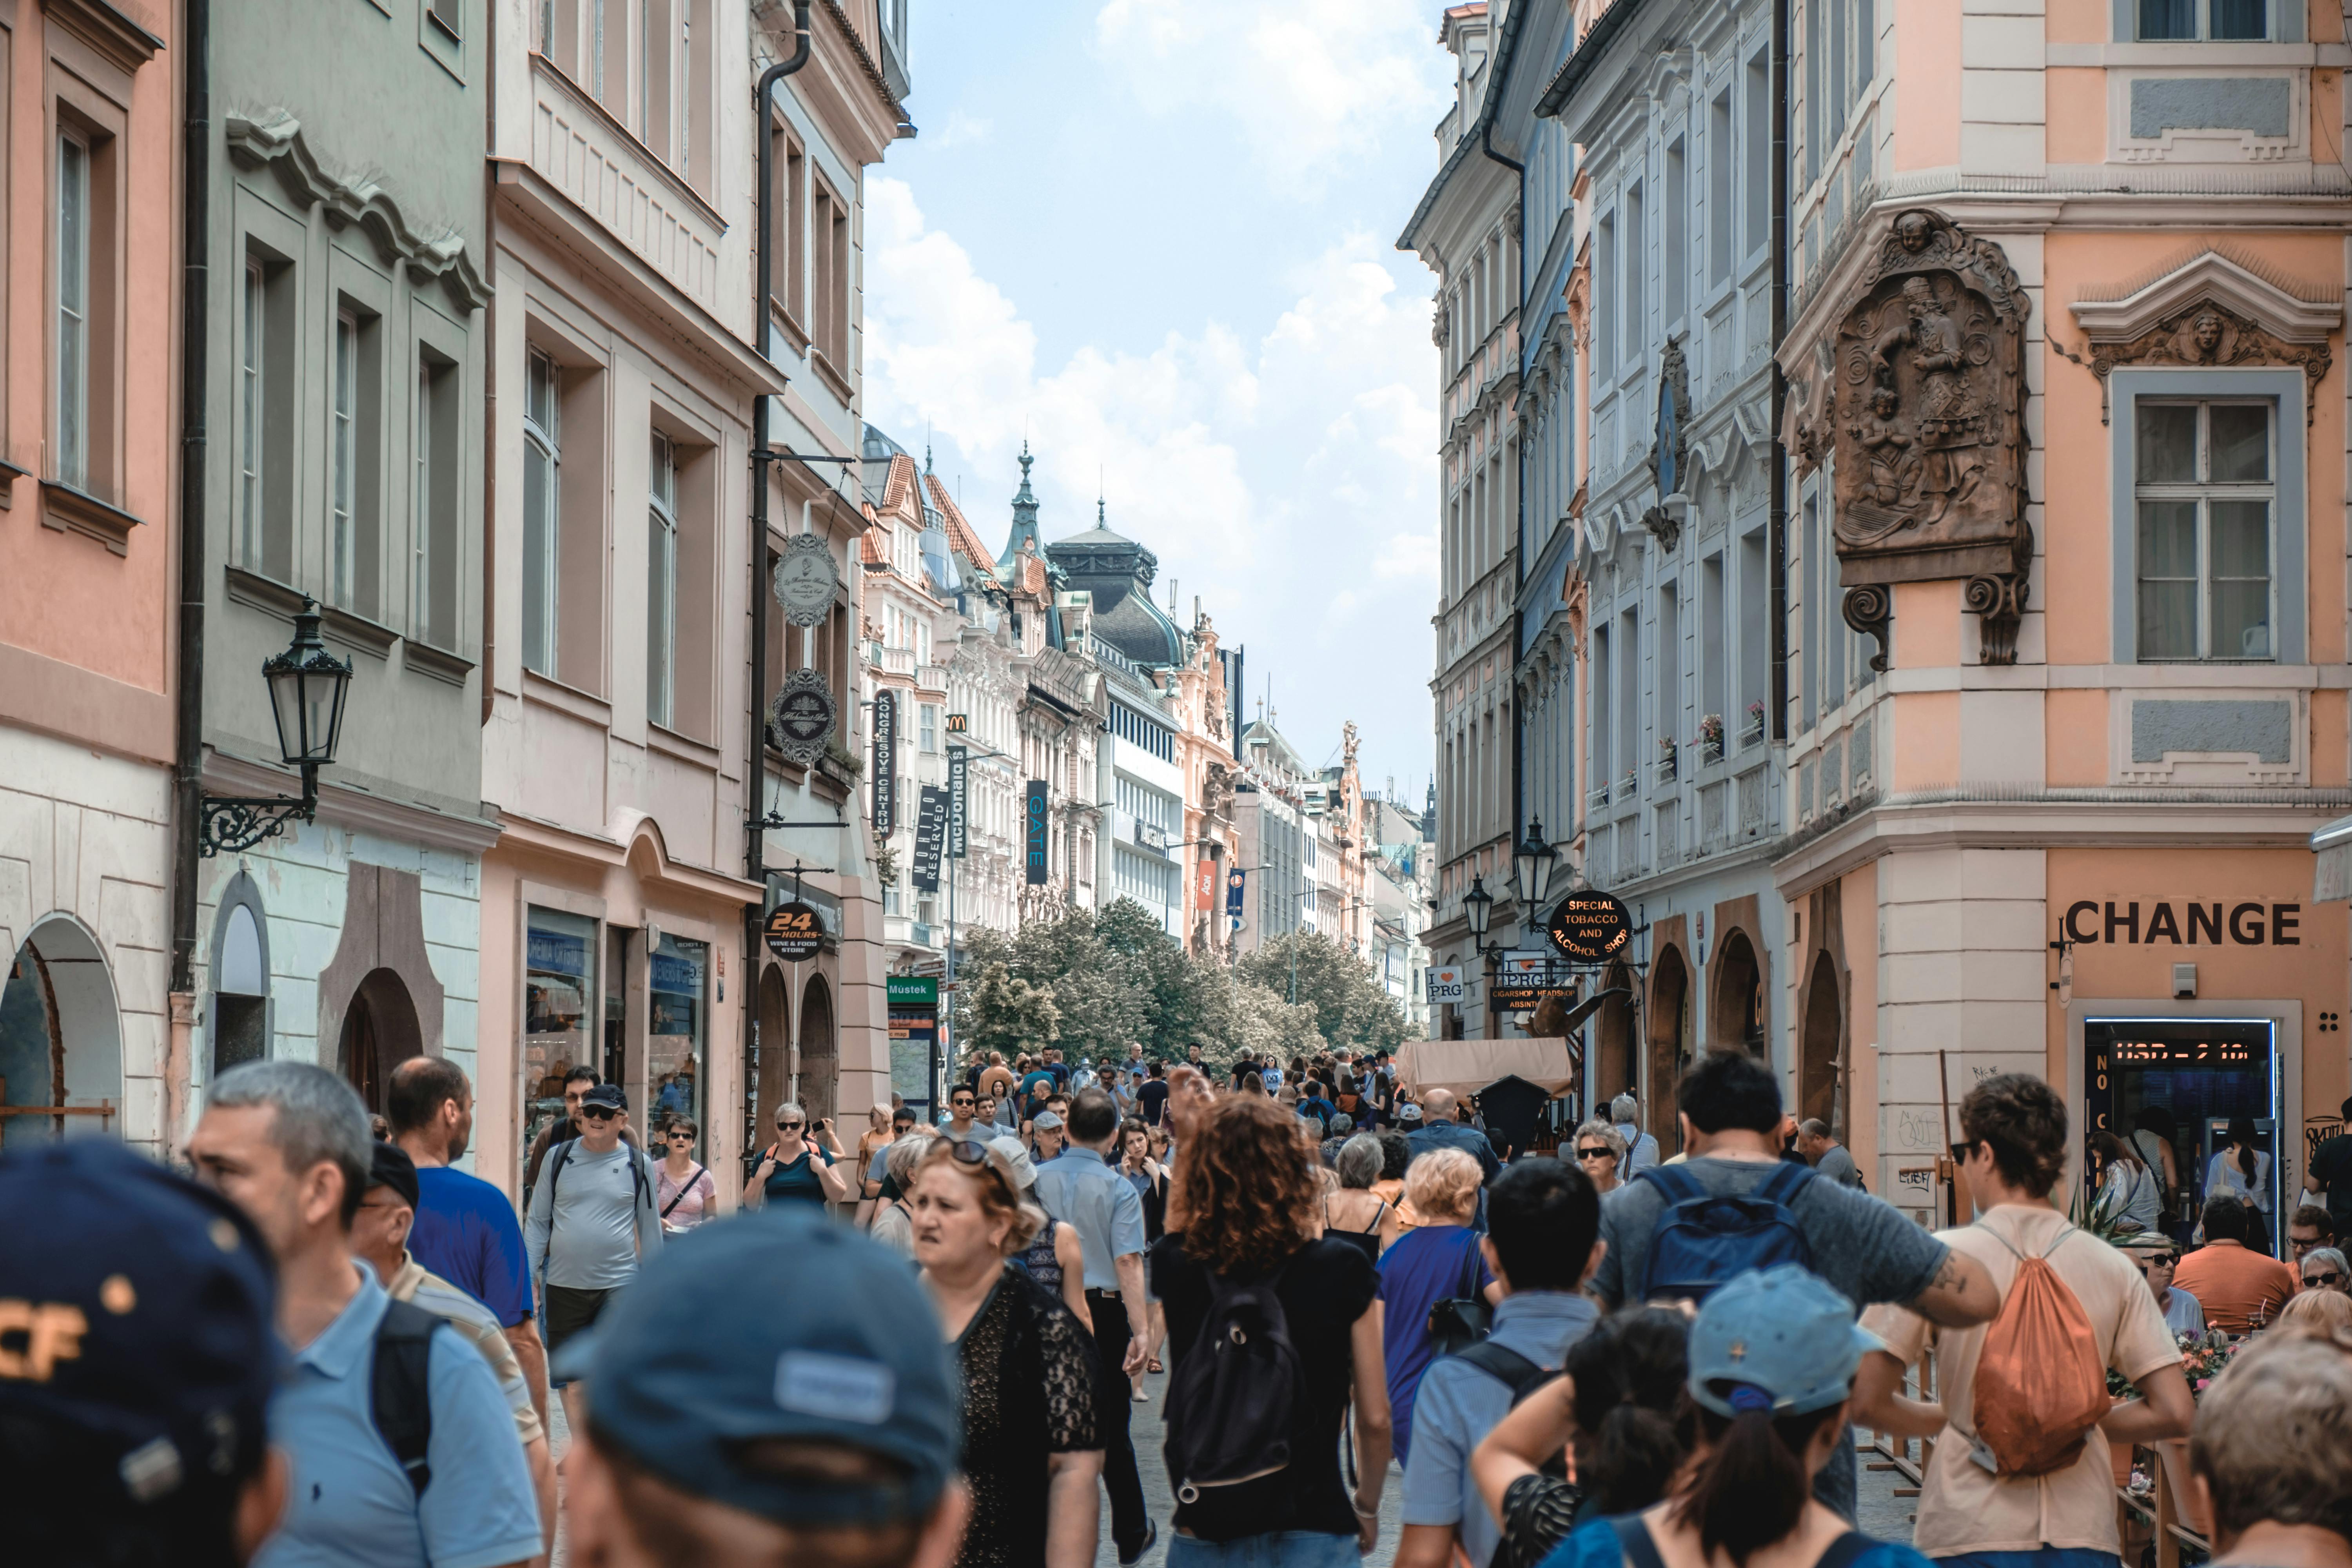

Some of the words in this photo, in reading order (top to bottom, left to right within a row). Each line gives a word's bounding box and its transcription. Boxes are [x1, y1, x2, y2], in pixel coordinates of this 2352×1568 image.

[780, 712, 813, 721] Alchemist
[878, 779, 889, 833] CENTRUM
[914, 798, 935, 874] MOHITO
[1029, 796, 1043, 866] GATE
[927, 805, 944, 880] RESERVED
[1569, 900, 1615, 910] SPECIAL
[771, 913, 812, 930] 24
[1564, 915, 1618, 924] TOBACCO
[2065, 900, 2300, 946] CHANGE
[1579, 929, 1602, 937] AND
[528, 936, 552, 962] OHEMIA
[1553, 929, 1599, 956] ALCOHOL
[1604, 929, 1627, 953] SHOP
[1428, 973, 1435, 985] I
[1505, 973, 1545, 987] PRG
[1429, 984, 1463, 997] PRG
